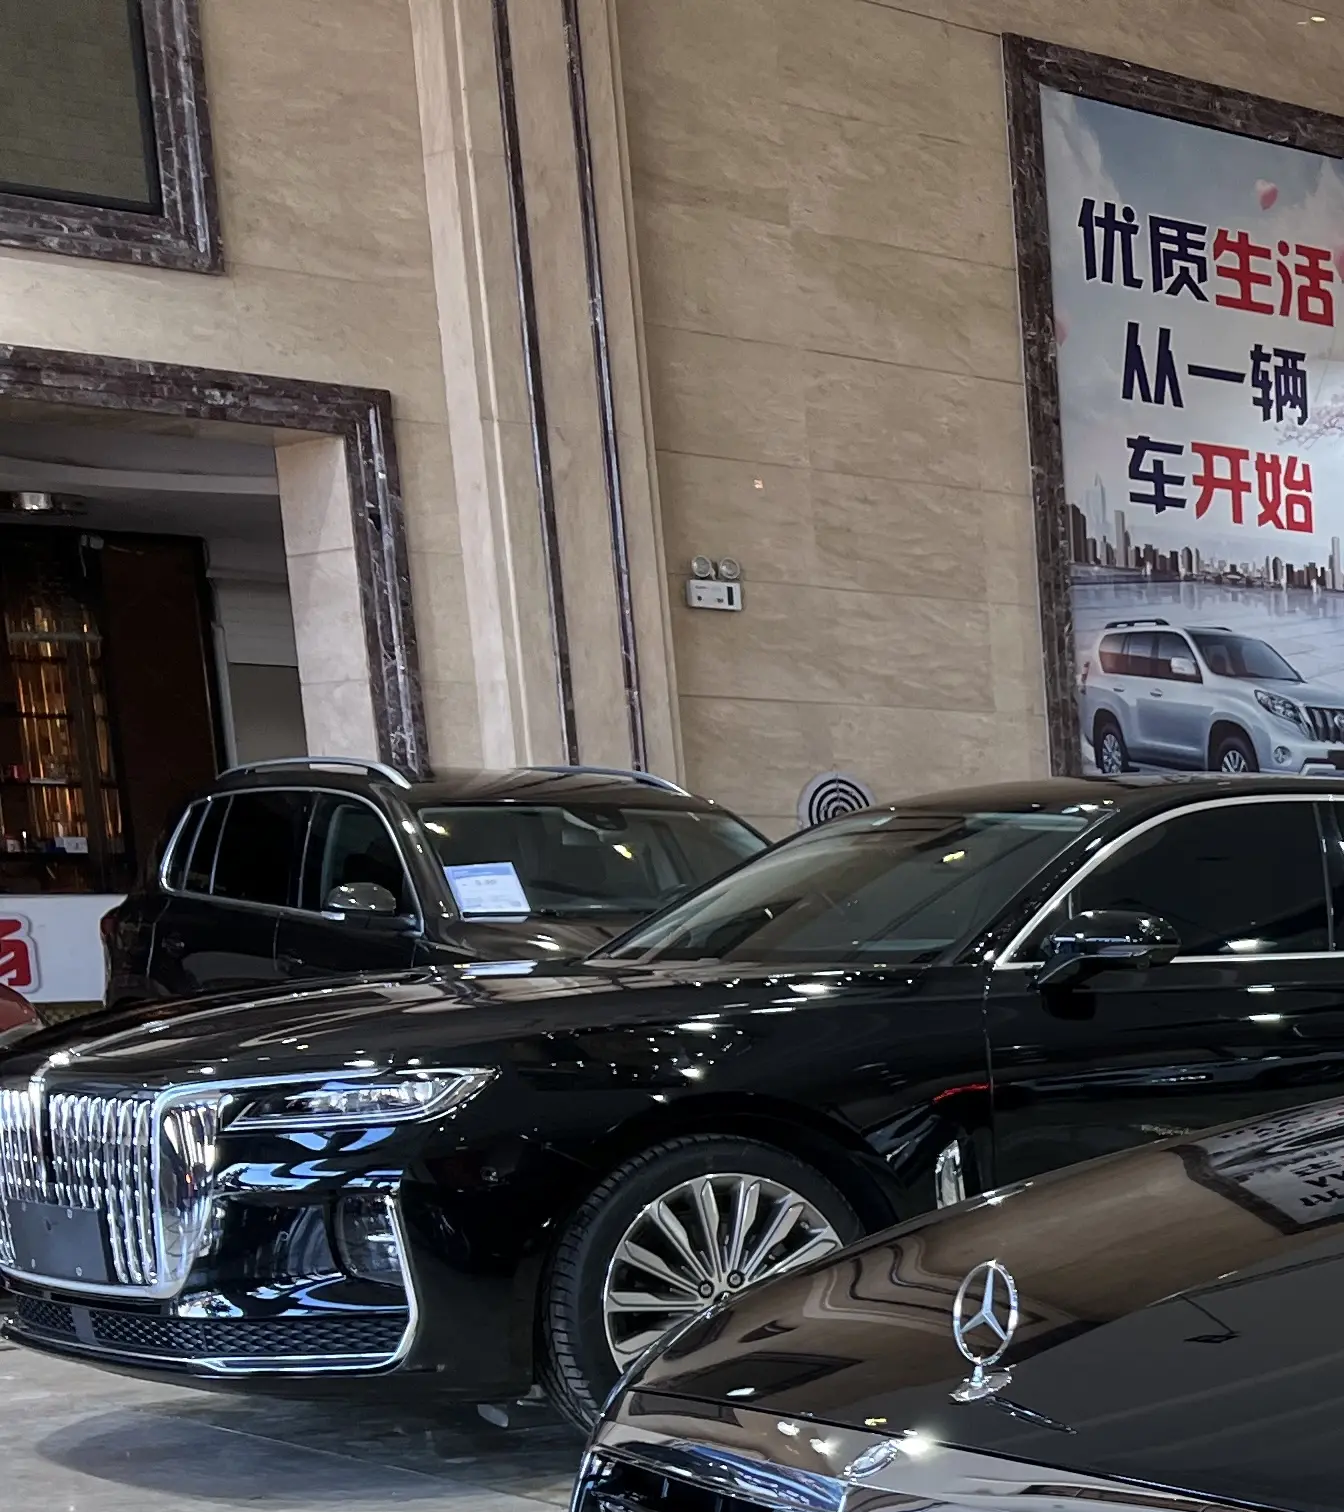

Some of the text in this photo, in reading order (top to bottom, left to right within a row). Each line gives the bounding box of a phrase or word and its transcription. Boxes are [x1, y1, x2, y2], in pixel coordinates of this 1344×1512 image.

[1077, 197, 1335, 327] 优质生活
[1122, 320, 1308, 426] 从一辆
[1126, 434, 1314, 534] 车开始
